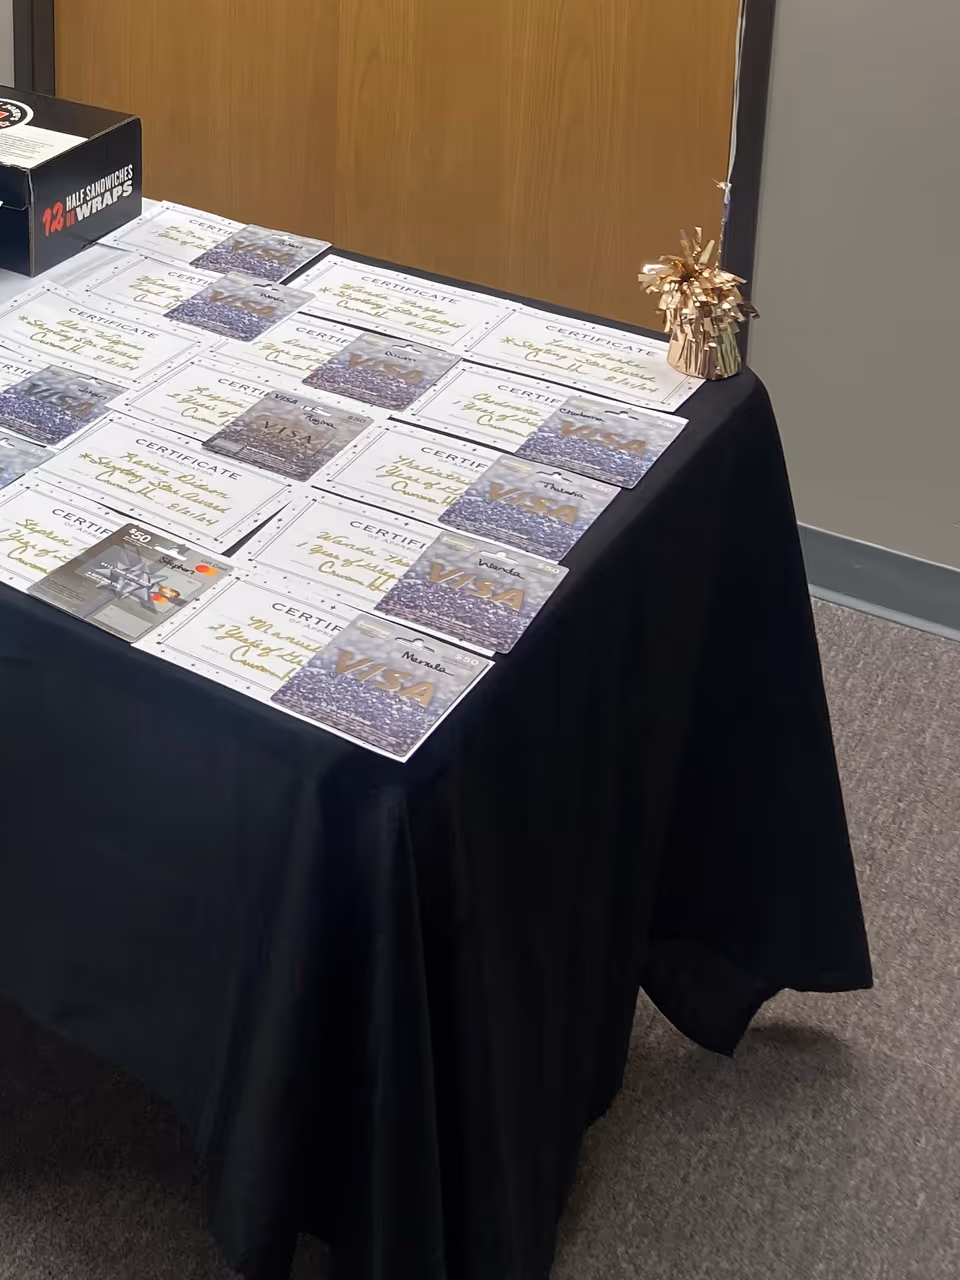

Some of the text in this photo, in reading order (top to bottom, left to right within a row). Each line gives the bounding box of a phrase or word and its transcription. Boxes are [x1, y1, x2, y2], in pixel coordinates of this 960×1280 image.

[65, 164, 133, 211] HALF SANDWICHES
[75, 179, 133, 222] WRAPS
[42, 201, 64, 237] 12
[189, 219, 233, 237] CERTI
[167, 271, 216, 286] CERTI
[361, 275, 458, 305] CERTIFICATE
[68, 306, 161, 340] CERTIFICATE
[295, 326, 352, 345] CERTIF
[544, 324, 661, 358] CERTIFICATE
[217, 377, 271, 397] CERTI
[273, 393, 299, 406] VISA
[497, 384, 567, 406] CERTIF
[262, 420, 313, 444] VISA
[135, 438, 242, 481] CERTIFICATE
[420, 446, 490, 471] CERTIF
[148, 478, 181, 495] Star
[181, 490, 233, 515] Award
[489, 481, 579, 526] VISA
[51, 507, 114, 536] CERTIF
[166, 501, 221, 528] 8/21/24
[76, 526, 103, 541] APPRE
[127, 527, 152, 544] $50
[349, 519, 427, 550] CERTIFI
[307, 544, 342, 563] Year
[342, 554, 361, 569] of
[477, 557, 526, 581] Wanda
[428, 561, 526, 613] VISA
[271, 602, 344, 632] CERTIF
[288, 617, 336, 640] OF APPRE
[454, 653, 480, 667] $50
[334, 648, 438, 710] VISA
